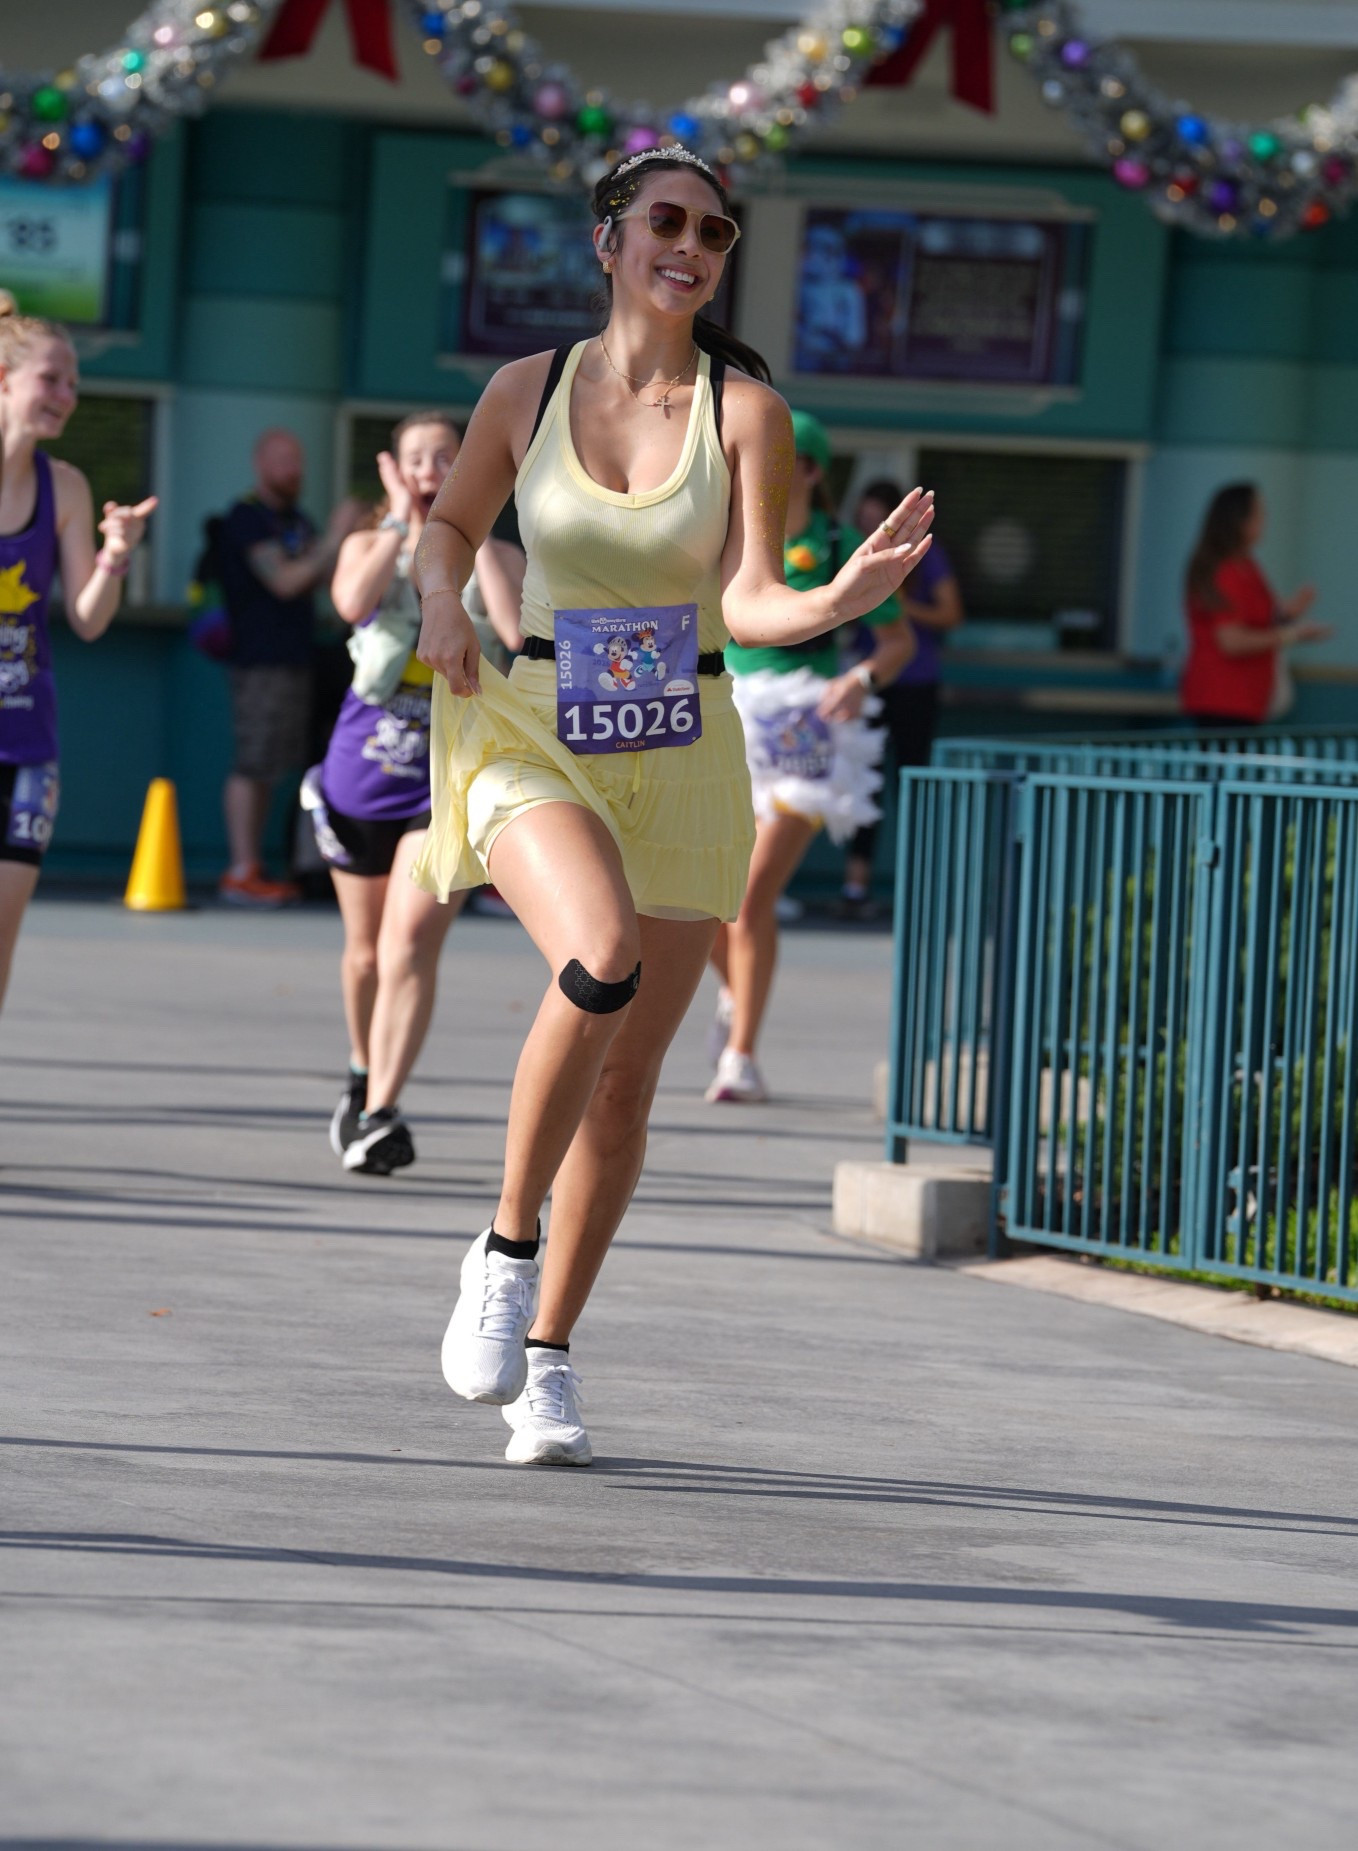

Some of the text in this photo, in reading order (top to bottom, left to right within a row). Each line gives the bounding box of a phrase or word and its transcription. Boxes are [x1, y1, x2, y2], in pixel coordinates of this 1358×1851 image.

[591, 620, 659, 633] MARATHON
[682, 614, 690, 631] F
[558, 640, 573, 690] 15026
[564, 698, 694, 741] 15026
[615, 740, 646, 749] CAITLIN
